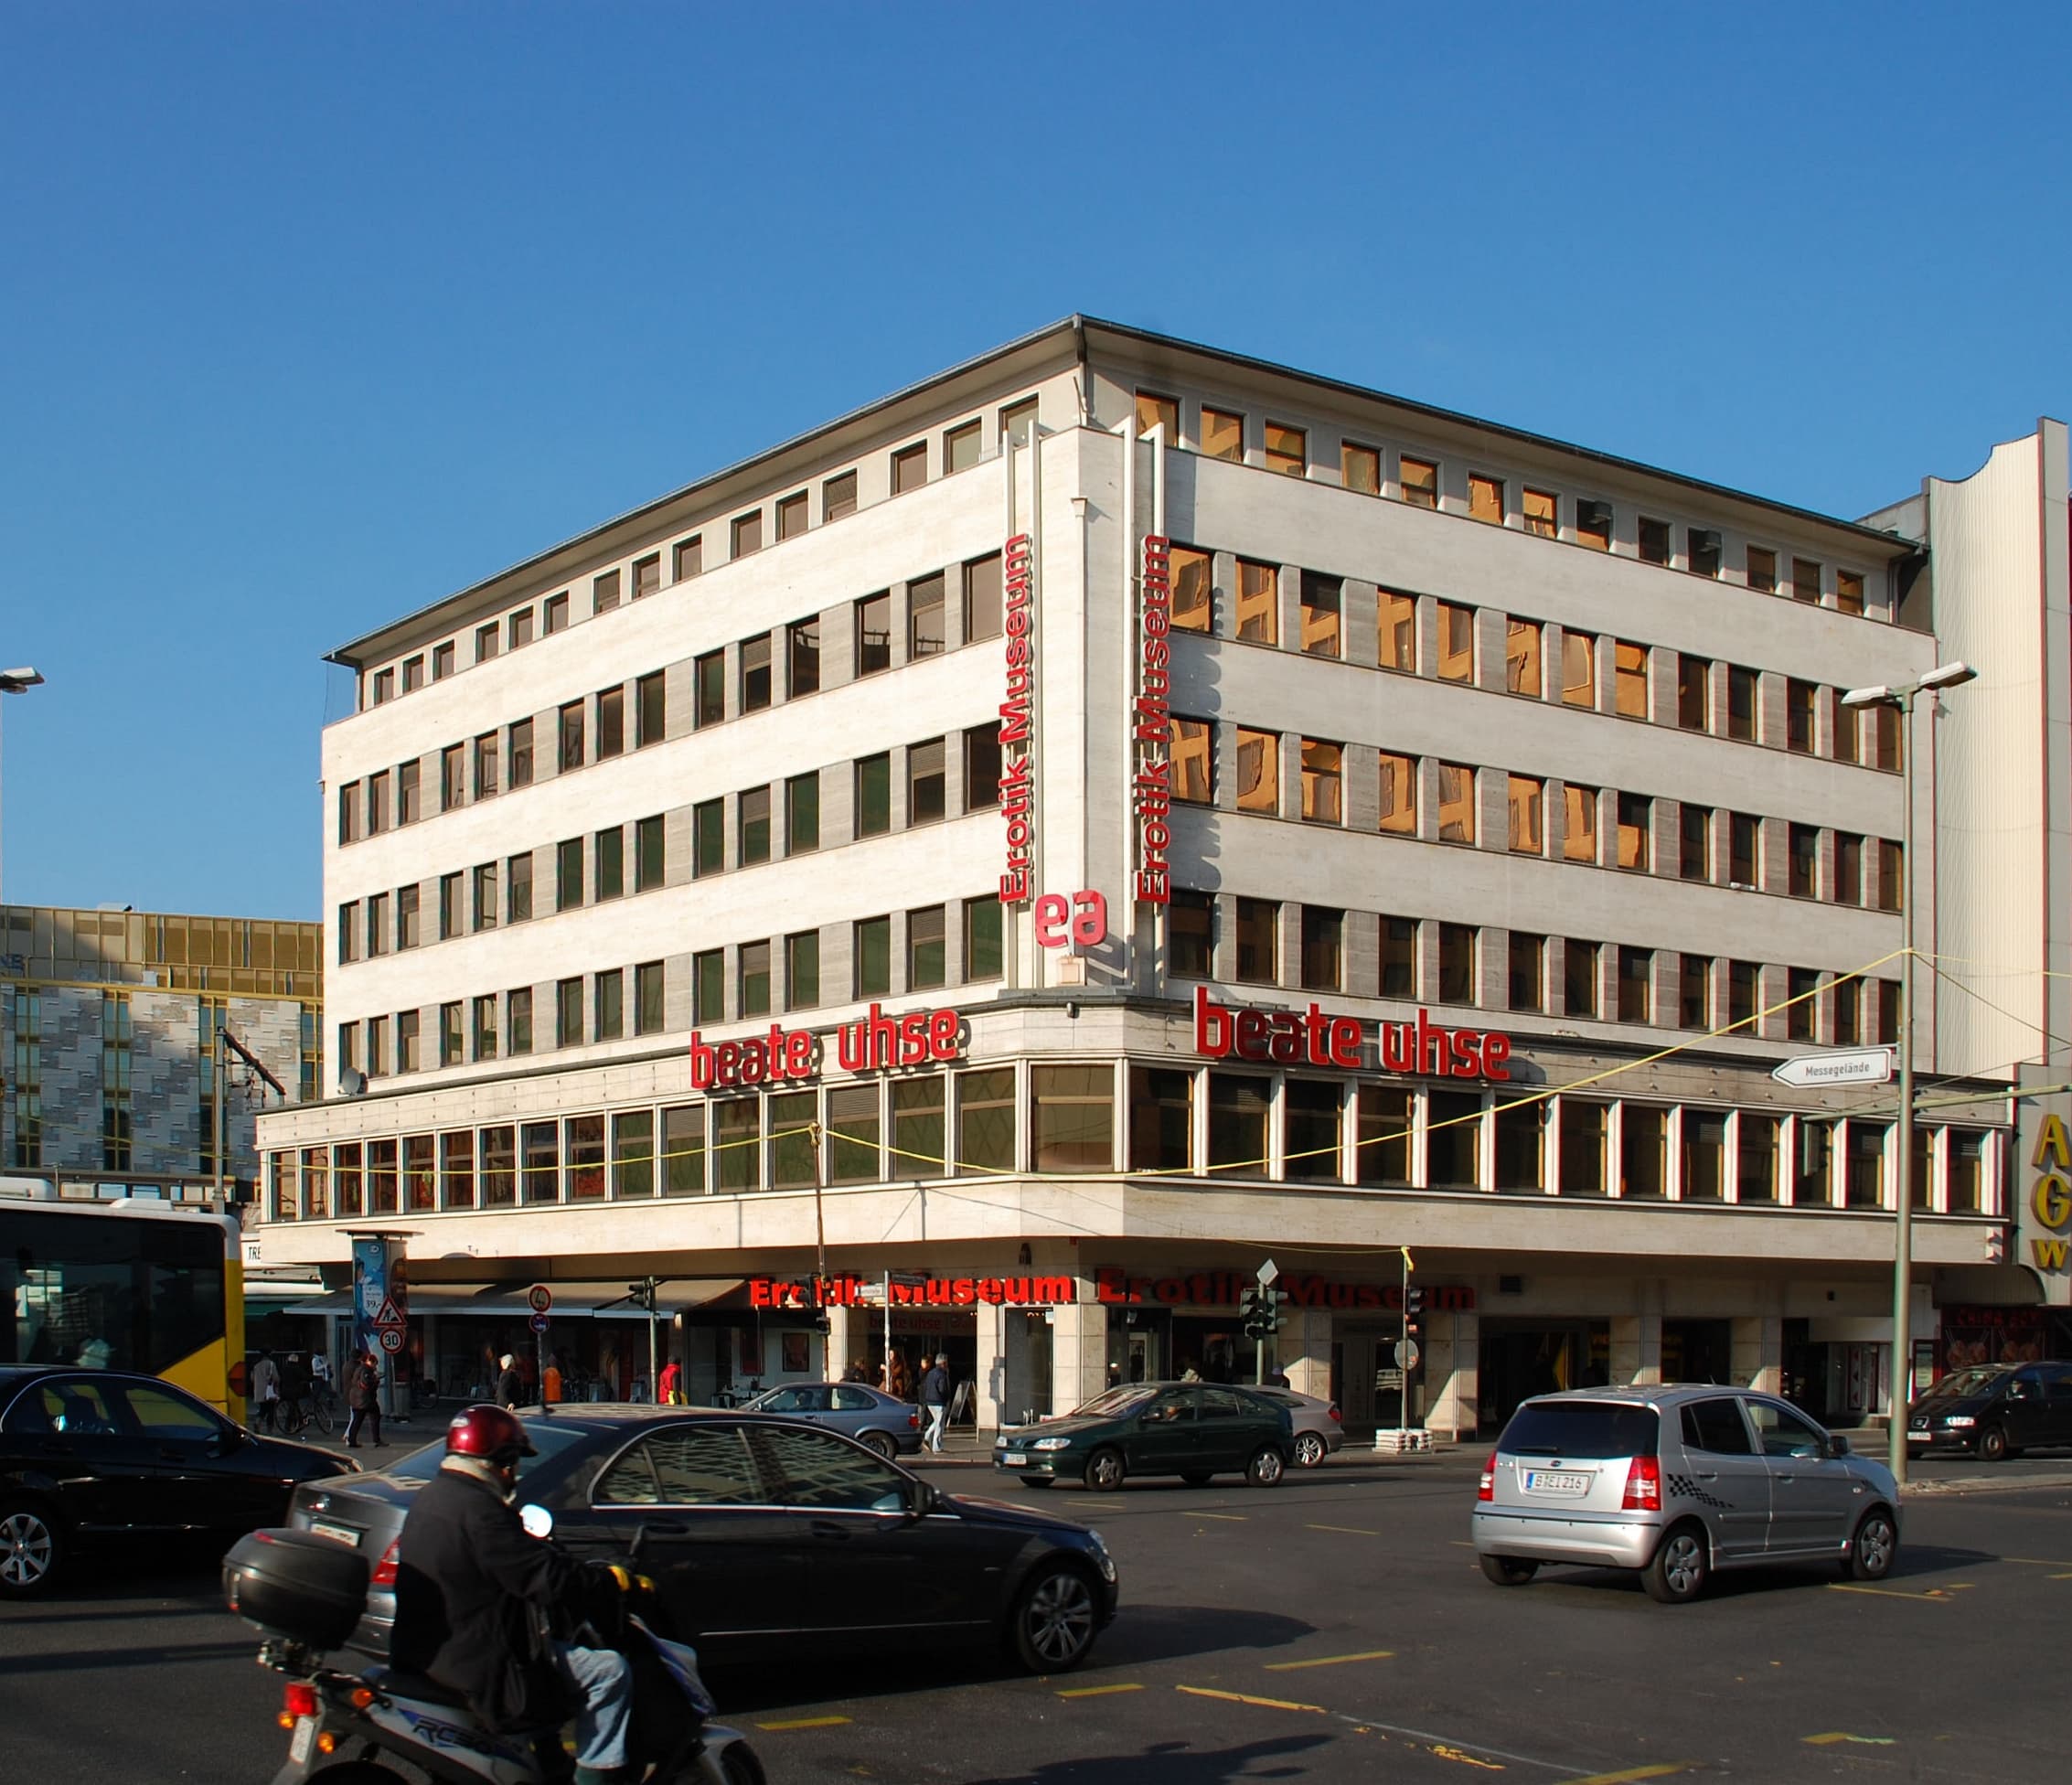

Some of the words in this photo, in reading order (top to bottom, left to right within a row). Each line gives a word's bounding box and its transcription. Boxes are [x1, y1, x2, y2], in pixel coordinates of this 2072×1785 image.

[998, 532, 1031, 745] Museum
[1133, 533, 1170, 743] Museum
[999, 754, 1030, 903] Erotik
[1134, 758, 1170, 904] Erotik
[690, 1023, 812, 1089] beate
[837, 1002, 961, 1072] uhse
[1192, 985, 1362, 1068] beate
[1378, 1007, 1511, 1080] uhse
[1805, 1062, 1870, 1077] Messegelände
[887, 1275, 1073, 1305] Museum
[384, 1334, 399, 1346] 30
[1562, 1476, 1582, 1490] 216
